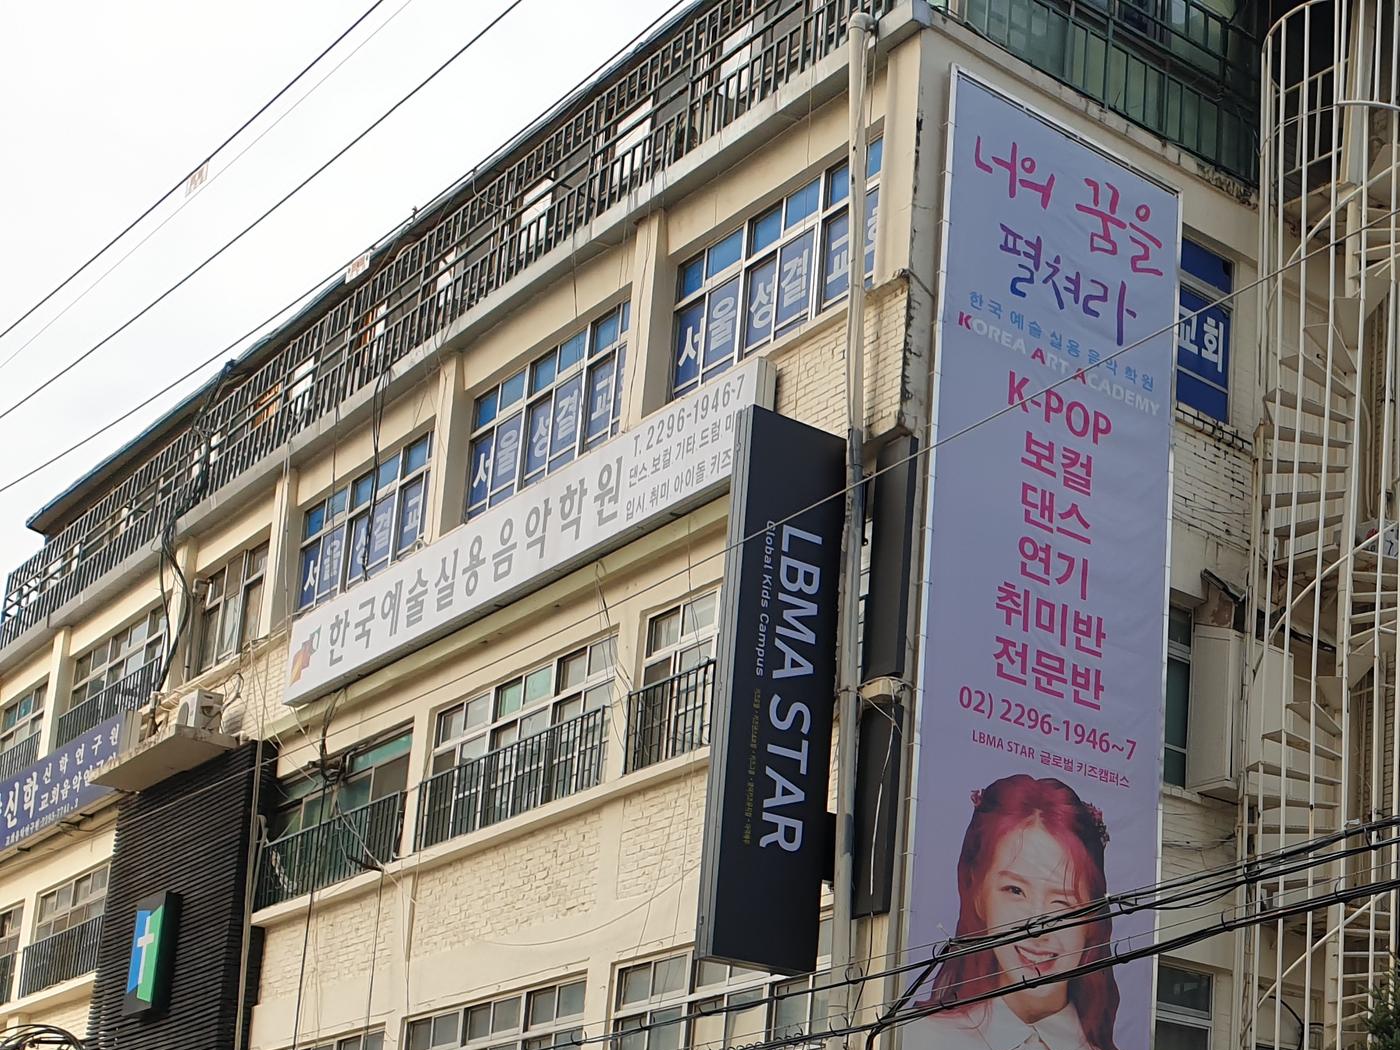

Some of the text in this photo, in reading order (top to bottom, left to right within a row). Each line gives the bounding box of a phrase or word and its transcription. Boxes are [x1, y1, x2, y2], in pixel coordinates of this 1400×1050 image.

[975, 135, 1163, 276] 너의 꿈을
[1000, 223, 1137, 346] 펼쳐라
[958, 311, 1160, 416] KOREA ART ACADEMY
[634, 374, 745, 457] T. 2296-1946-7
[1008, 370, 1112, 445] K-POP
[1021, 431, 1093, 497] 보컬
[1021, 481, 1092, 545] 댄스
[328, 456, 624, 667] 한국예술실용음악학원
[756, 520, 776, 677] Global Kids Campus
[1018, 536, 1089, 600] 연기
[996, 581, 1106, 658] 취미반
[759, 524, 823, 852] LBMA STAR
[993, 636, 1104, 711] 전문반
[959, 686, 1137, 760] 02) 2296-1946~7
[972, 729, 1130, 788] LBMA STAR 글로벌 키즈캠퍼스
[0, 771, 39, 829] 신학
